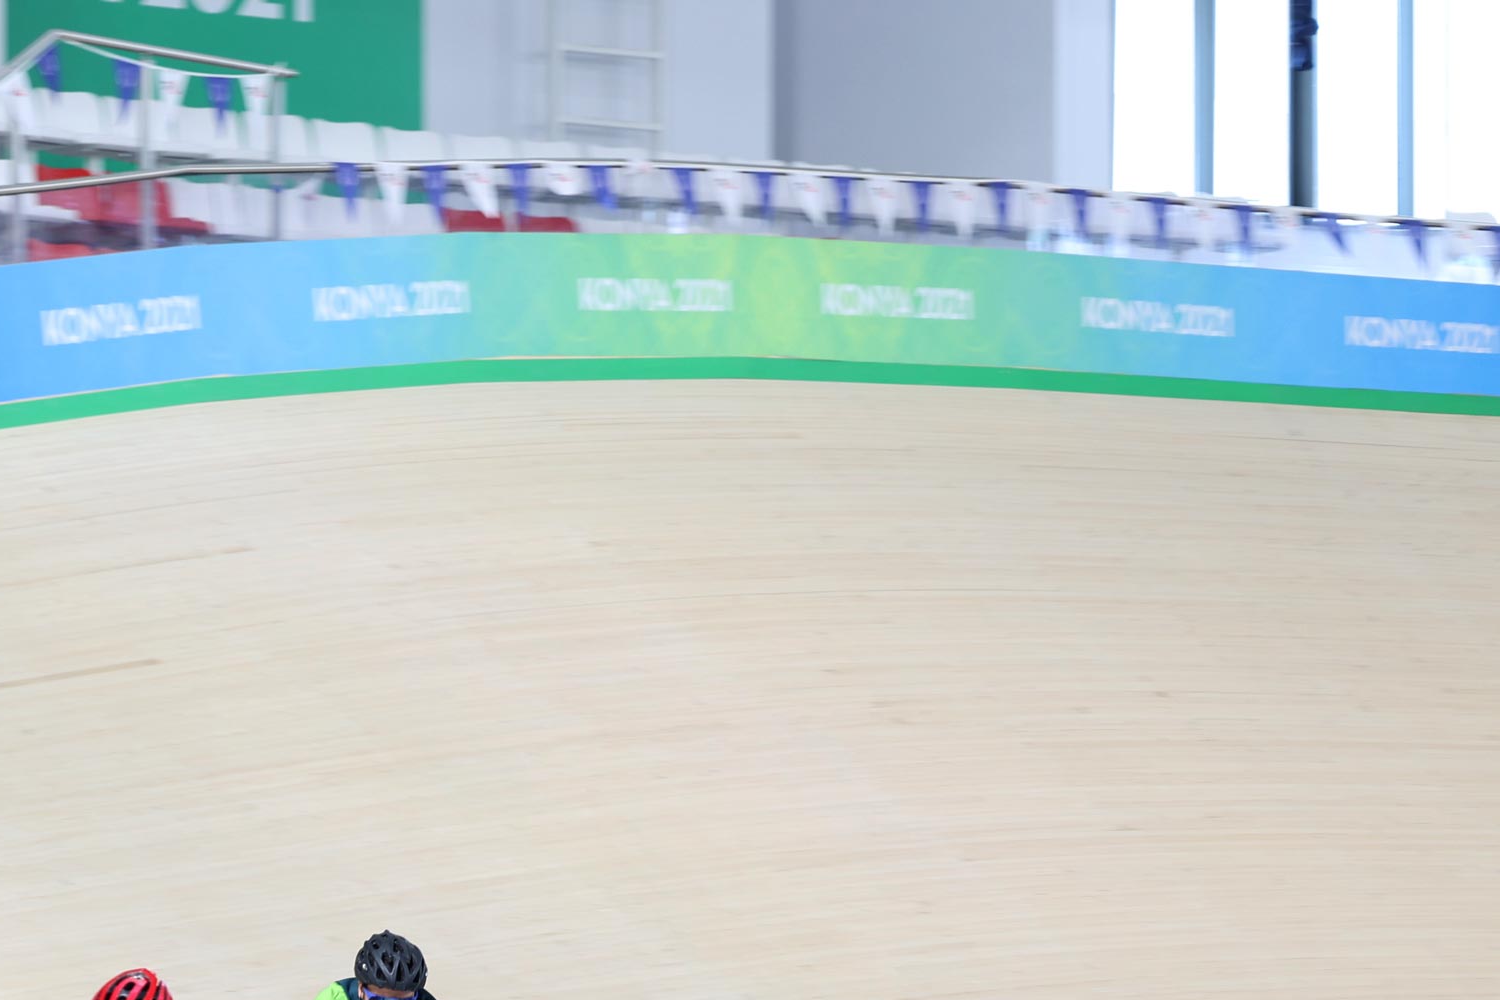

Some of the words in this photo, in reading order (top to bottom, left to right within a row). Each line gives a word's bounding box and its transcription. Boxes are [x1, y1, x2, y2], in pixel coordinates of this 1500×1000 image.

[312, 283, 401, 322] KONYA
[397, 280, 471, 315] 2021
[576, 277, 667, 311] KONYA
[664, 279, 732, 311] 2021
[819, 282, 911, 318] KONYA
[911, 287, 975, 320] 2021
[40, 302, 139, 346] KONYA
[135, 295, 202, 334] 2021
[1080, 296, 1177, 334] KONYA
[1172, 303, 1235, 337] 2021
[1343, 315, 1438, 351] KONYA
